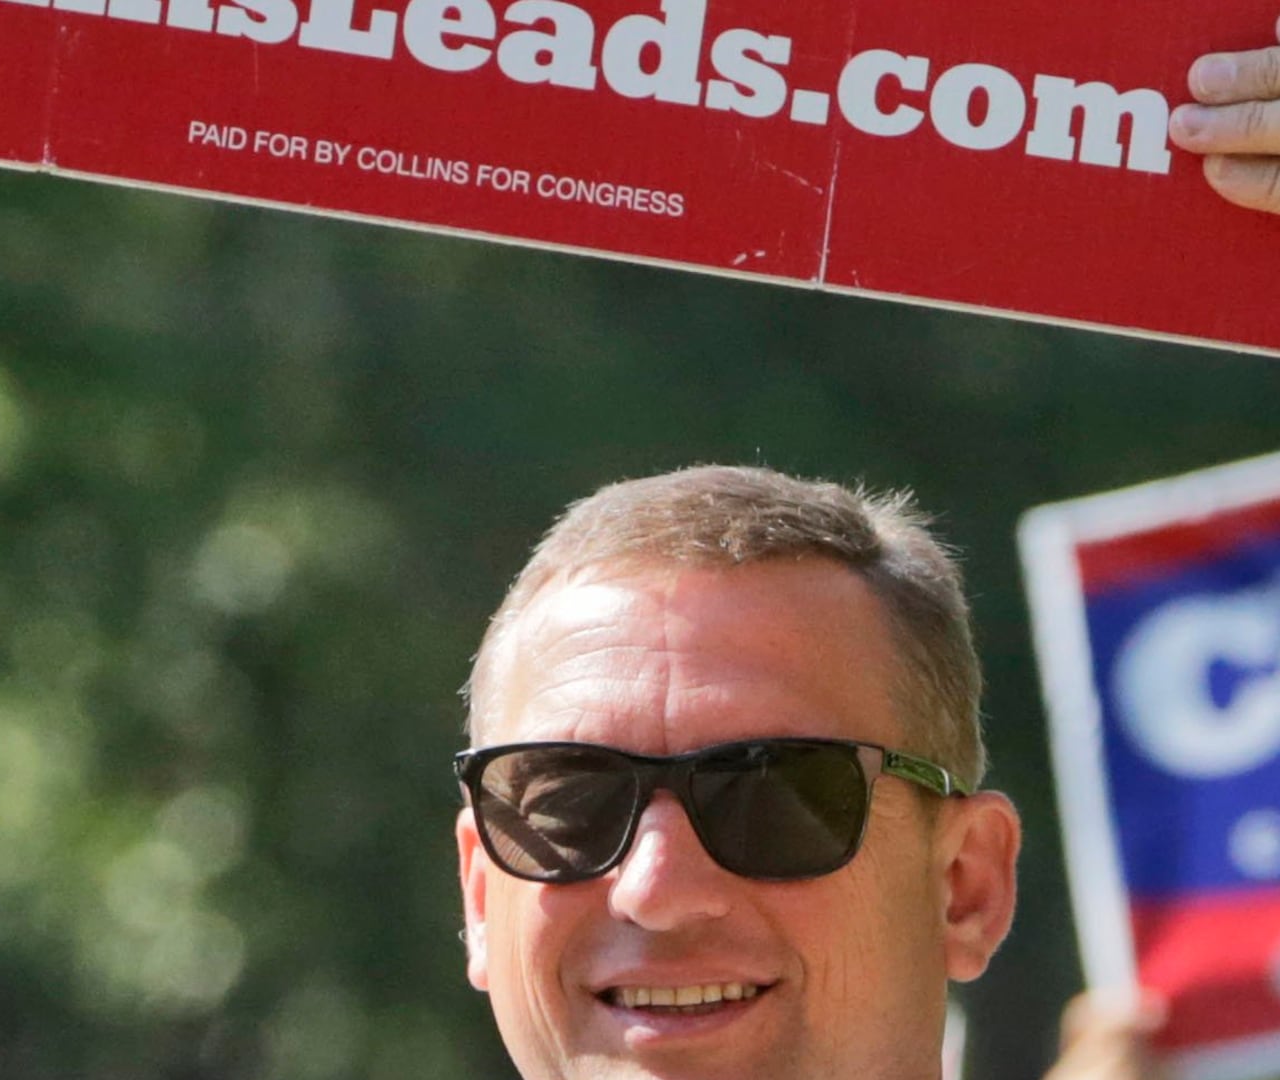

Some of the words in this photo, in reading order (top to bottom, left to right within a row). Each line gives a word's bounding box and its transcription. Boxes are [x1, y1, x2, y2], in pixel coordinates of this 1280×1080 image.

[188, 121, 248, 150] PAID
[253, 131, 309, 160] FOR
[314, 141, 353, 165] BY
[356, 147, 470, 185] COLLINS
[475, 164, 532, 194] FOR
[536, 174, 685, 217] CONGRESS
